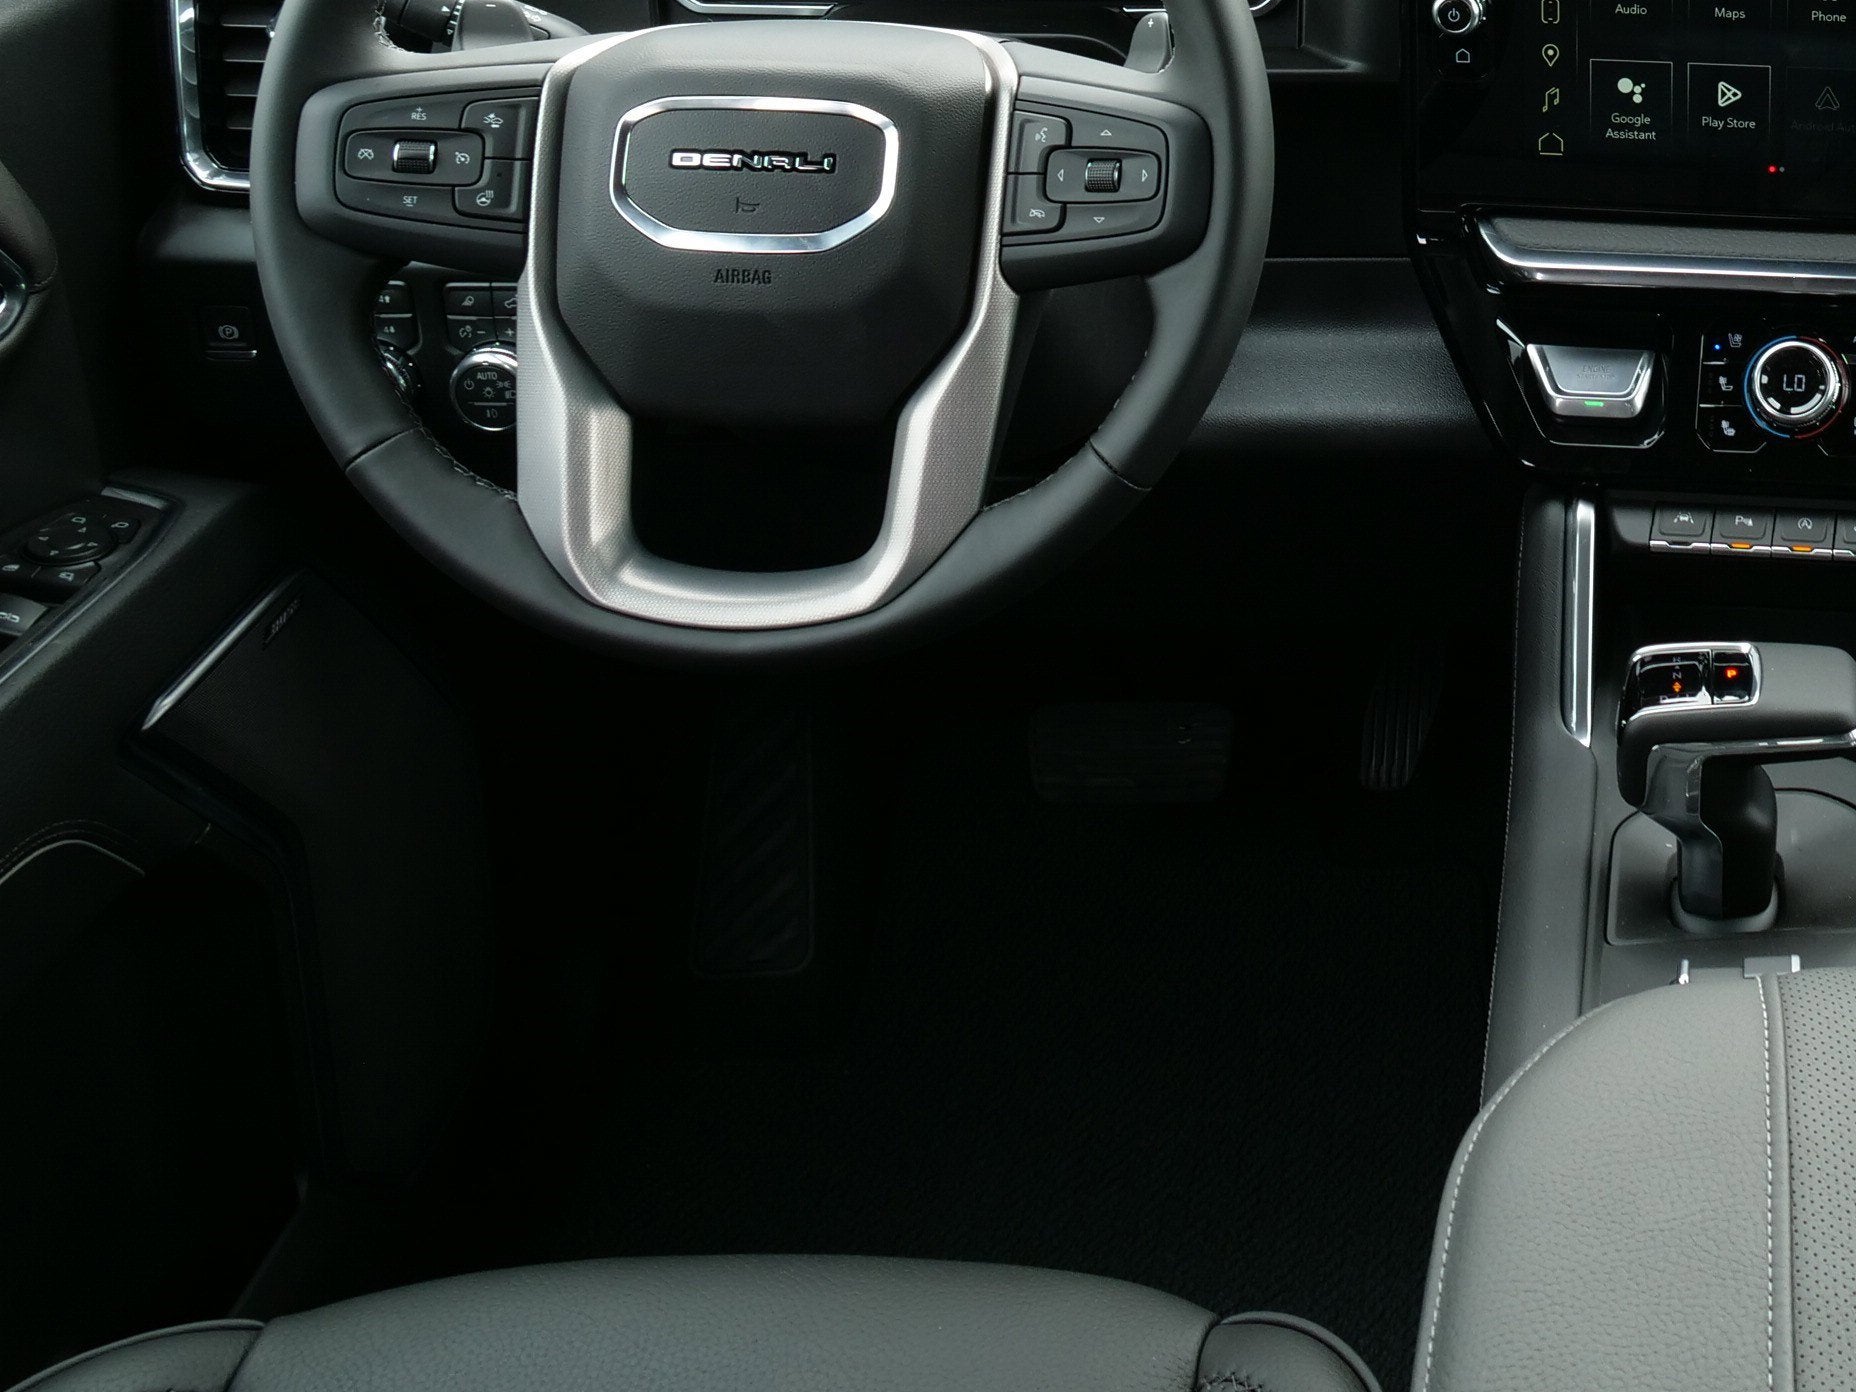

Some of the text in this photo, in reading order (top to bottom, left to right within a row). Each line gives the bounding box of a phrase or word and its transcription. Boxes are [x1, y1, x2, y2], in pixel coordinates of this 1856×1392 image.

[1615, 3, 1648, 15] Audio
[1714, 7, 1747, 21] Maps
[1811, 10, 1847, 23] Phone
[411, 111, 428, 121] RES
[1611, 112, 1651, 128] Google
[1701, 116, 1757, 130] Play Store
[1605, 128, 1657, 140] Assistant
[670, 151, 835, 171] DENALI
[402, 195, 418, 205] SET
[713, 268, 773, 285] AIRBAG
[477, 371, 498, 381] AUTO
[1726, 667, 1737, 679] P
